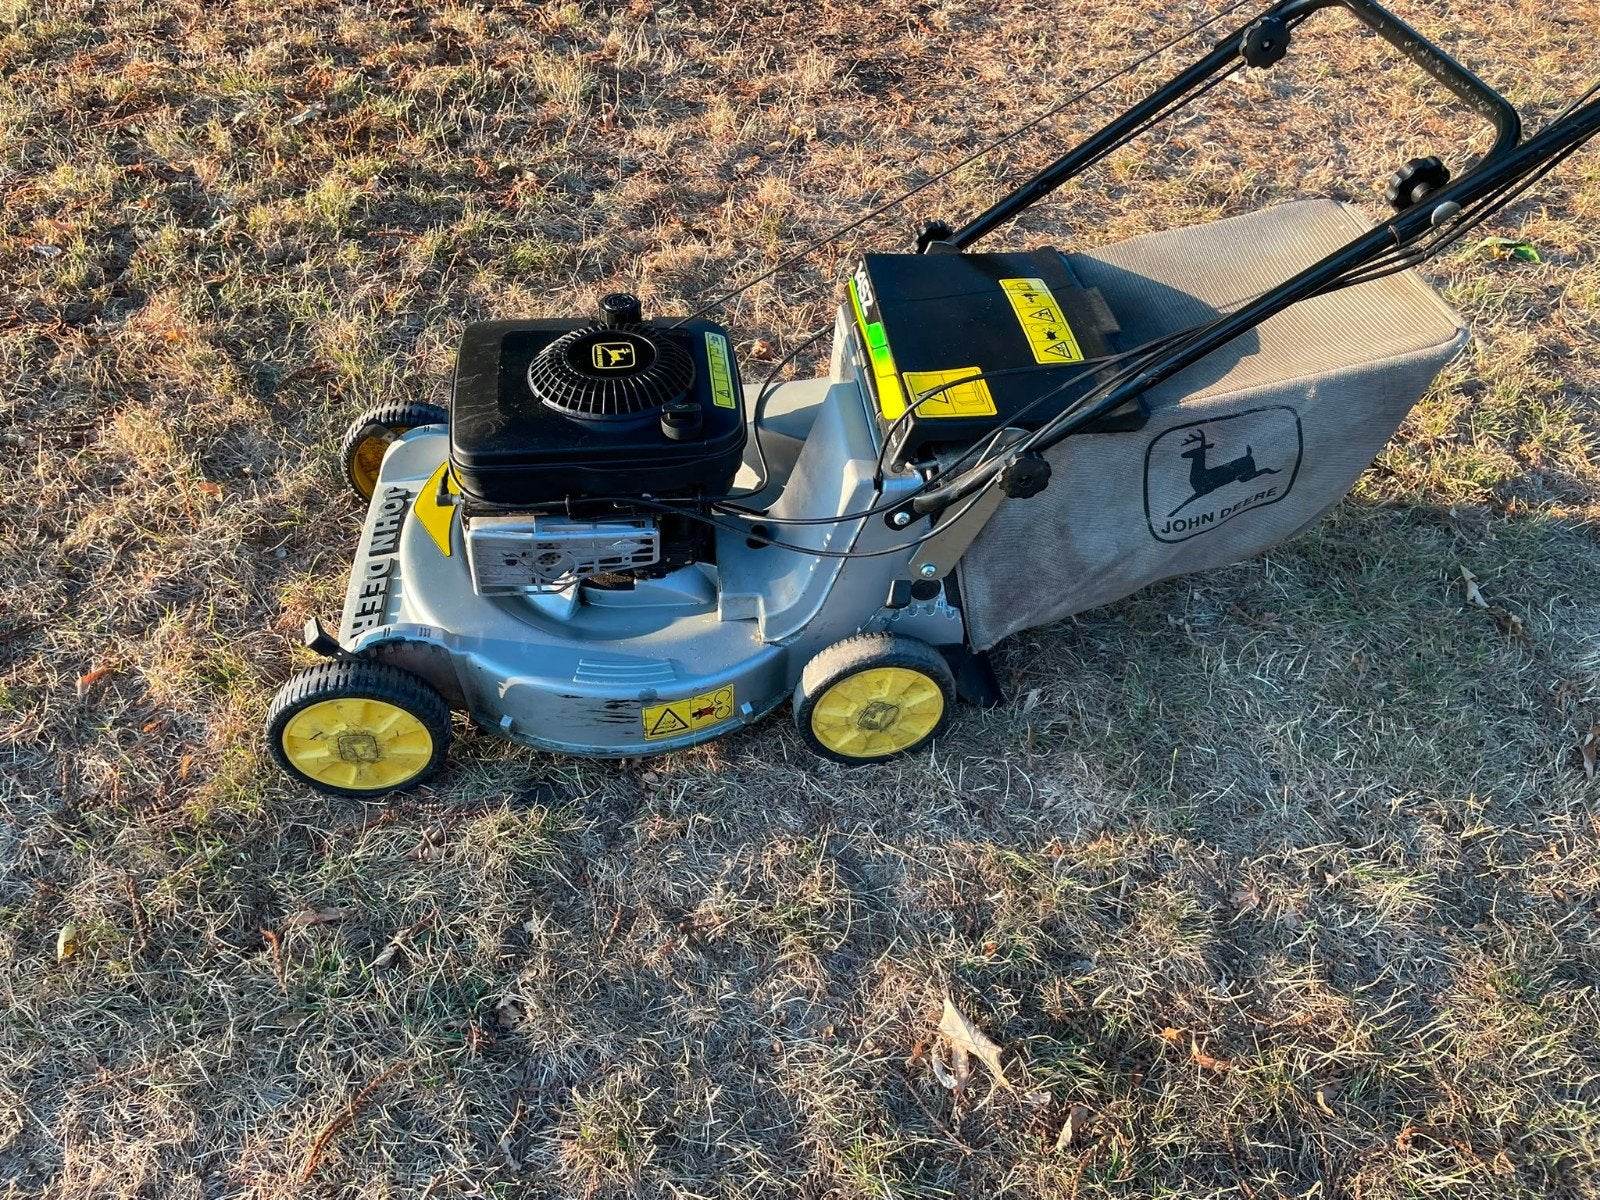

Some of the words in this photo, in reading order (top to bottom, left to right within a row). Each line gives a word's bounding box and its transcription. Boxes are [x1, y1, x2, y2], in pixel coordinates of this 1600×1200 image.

[368, 486, 411, 557] JOHN
[1161, 512, 1214, 534] JOHN
[1220, 487, 1278, 519] DEERE
[350, 557, 394, 638] DEER
